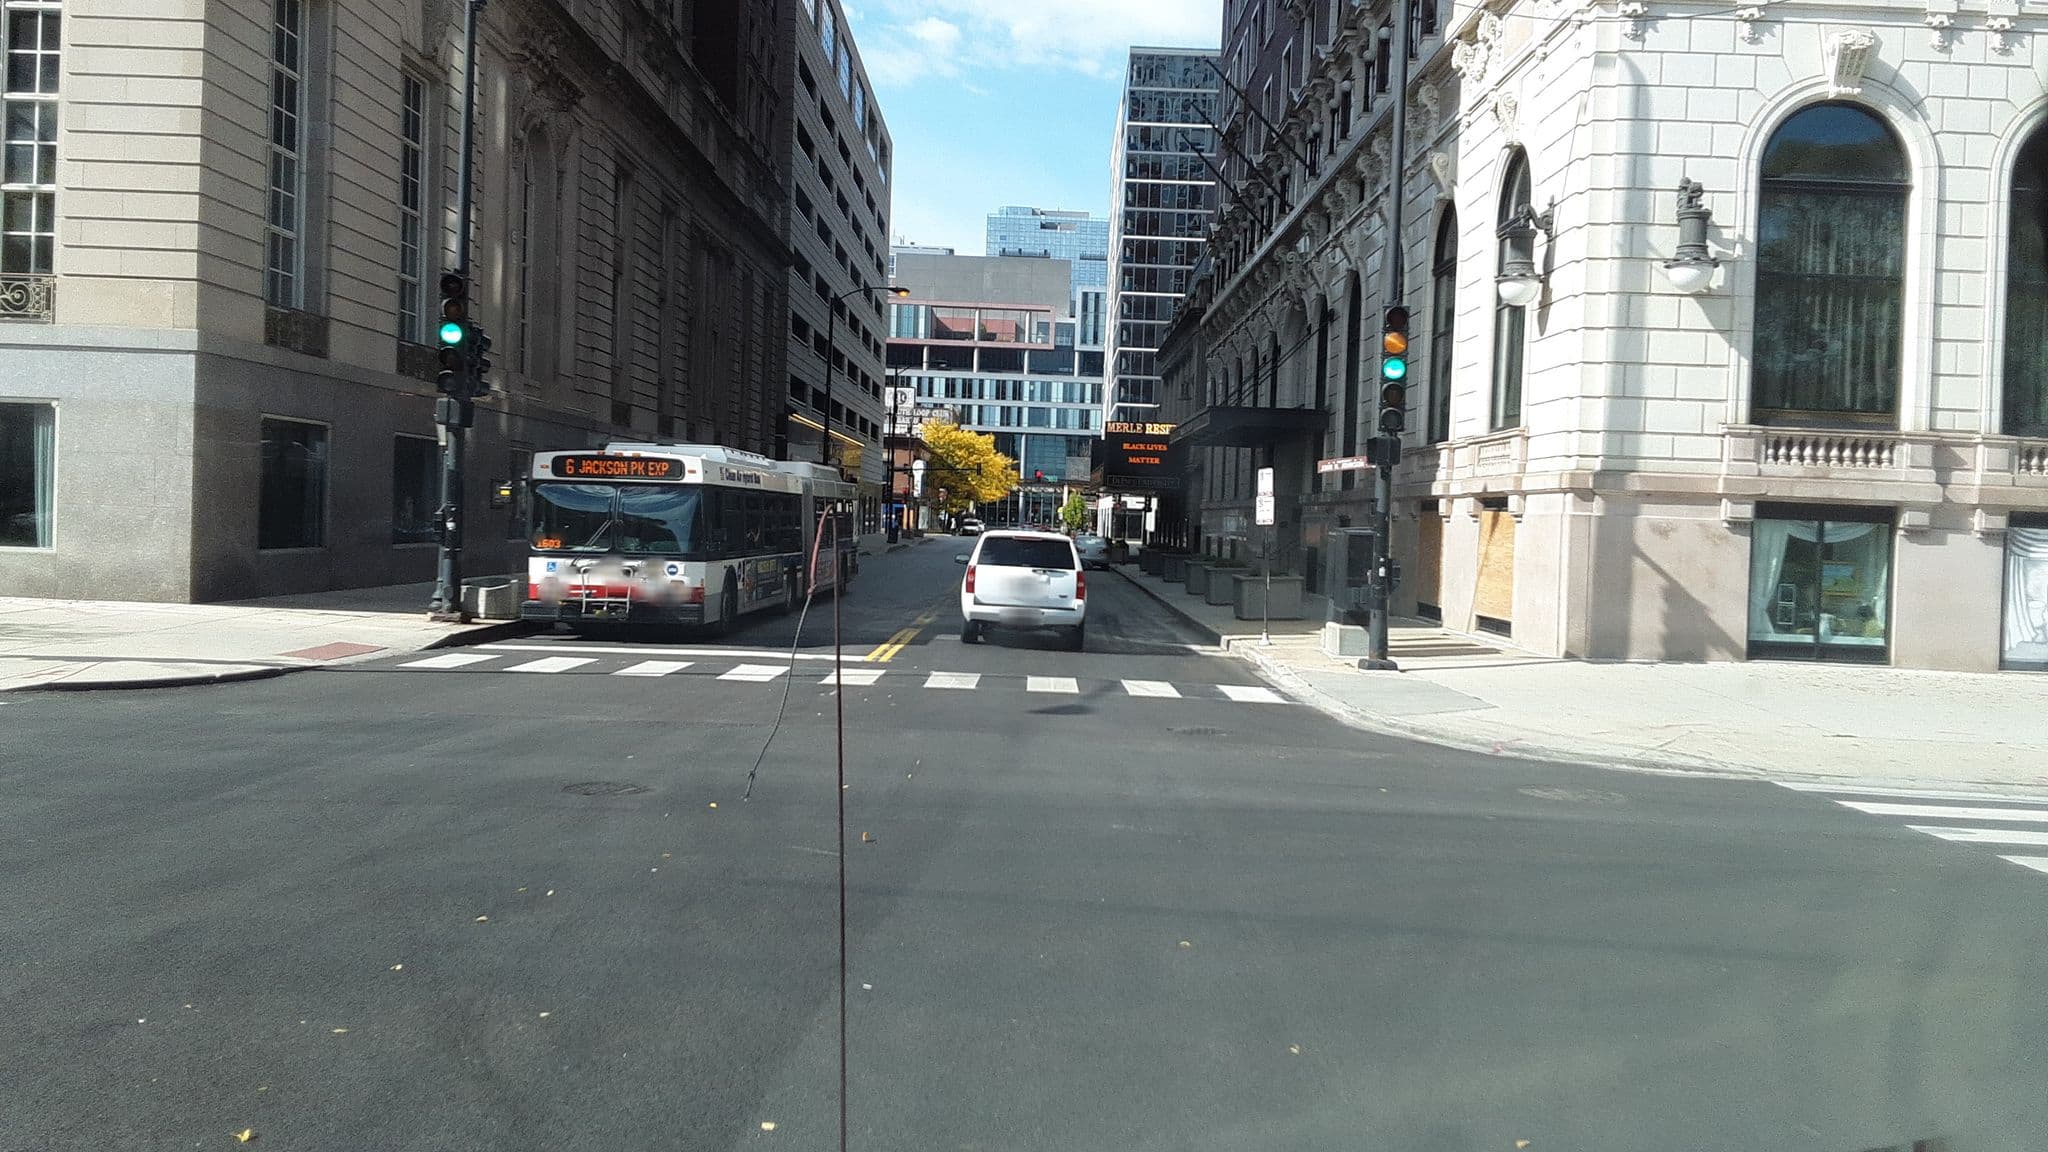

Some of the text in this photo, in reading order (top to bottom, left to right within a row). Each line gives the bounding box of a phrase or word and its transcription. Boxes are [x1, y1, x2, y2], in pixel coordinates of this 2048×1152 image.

[1106, 422, 1143, 434] MERLE
[1128, 456, 1161, 464] MATTER
[566, 459, 669, 476] 6 JACKSON PK EXP
